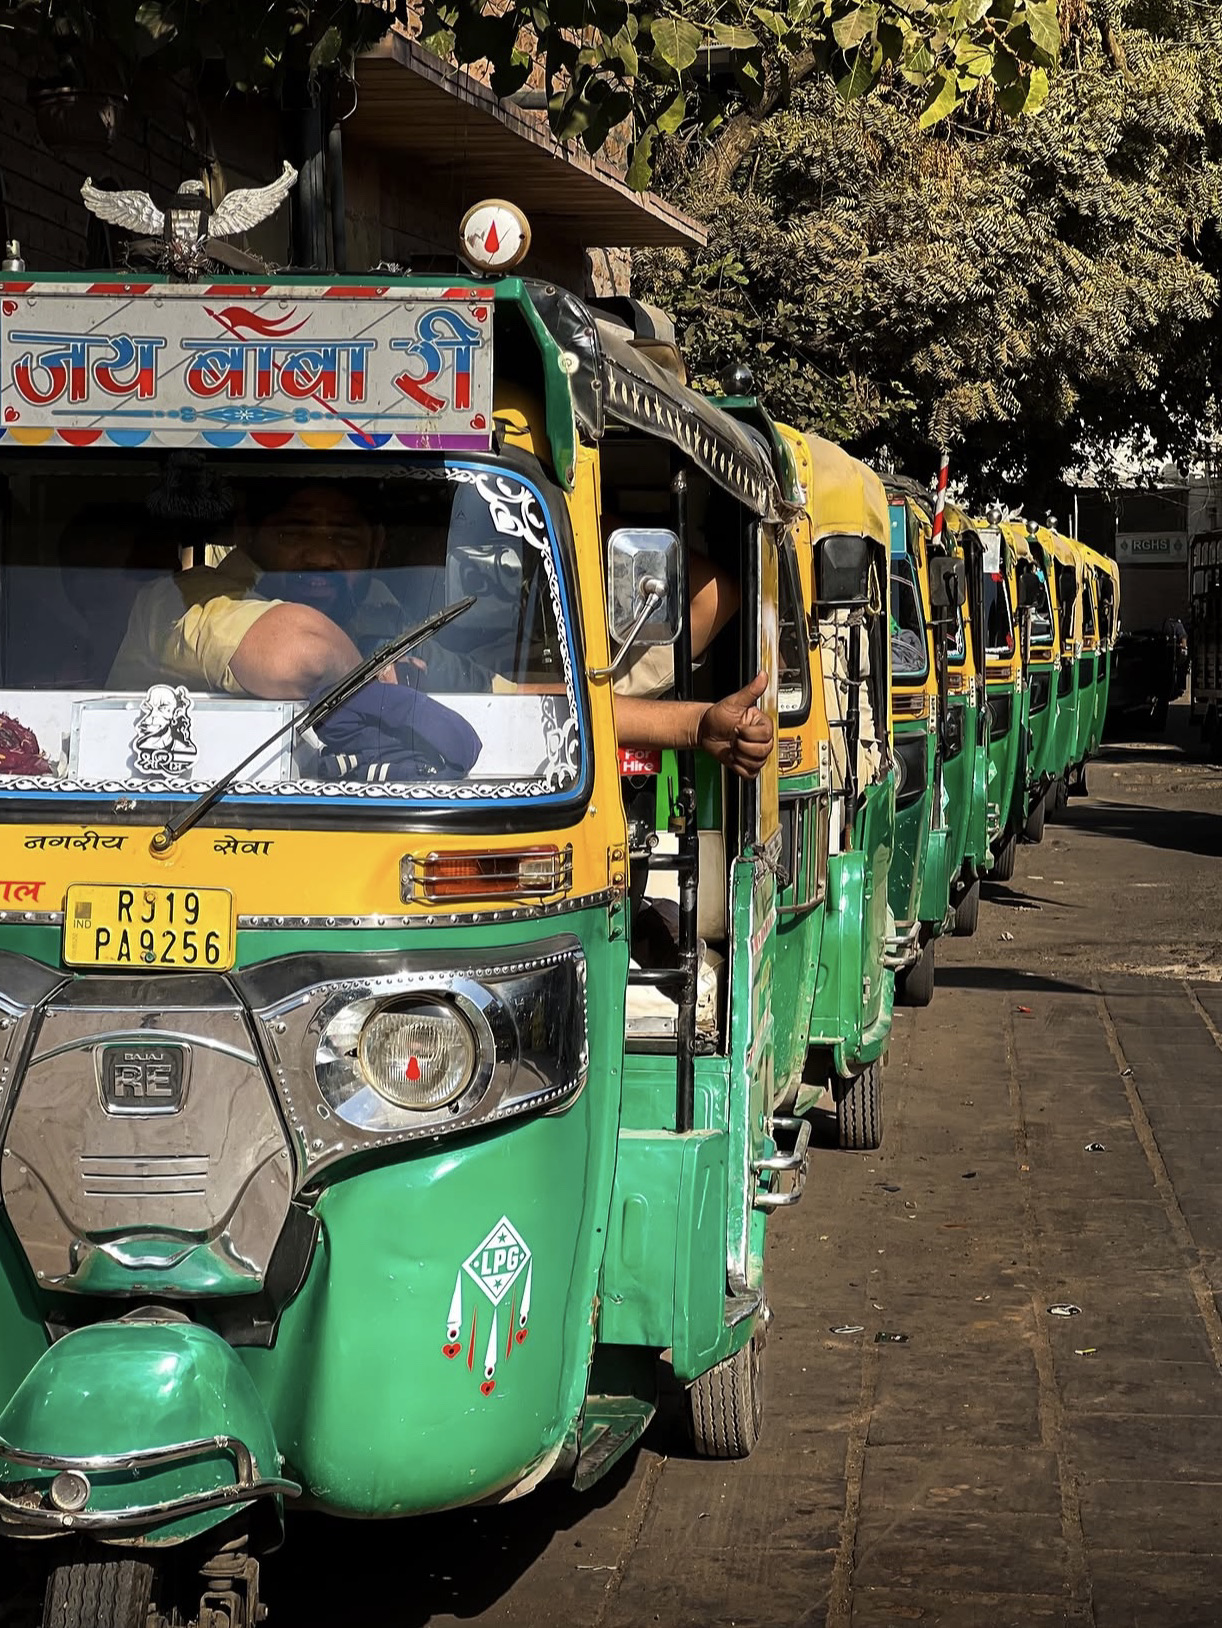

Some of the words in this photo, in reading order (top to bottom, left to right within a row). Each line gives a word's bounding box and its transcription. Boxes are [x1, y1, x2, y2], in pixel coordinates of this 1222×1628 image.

[8, 329, 167, 405] जय
[180, 336, 377, 402] बाबा
[388, 308, 486, 414] री
[1133, 540, 1168, 550] RGHS
[624, 748, 652, 760] For
[623, 760, 654, 772] Hire
[24, 830, 129, 851] नगरीय
[213, 835, 275, 856] सेवा
[0, 880, 46, 903] ाल
[73, 919, 92, 929] IND
[95, 927, 221, 965] PA9256
[124, 1053, 164, 1061] BAJAJ
[114, 1064, 172, 1096] RE
[480, 1246, 520, 1276] LPG
